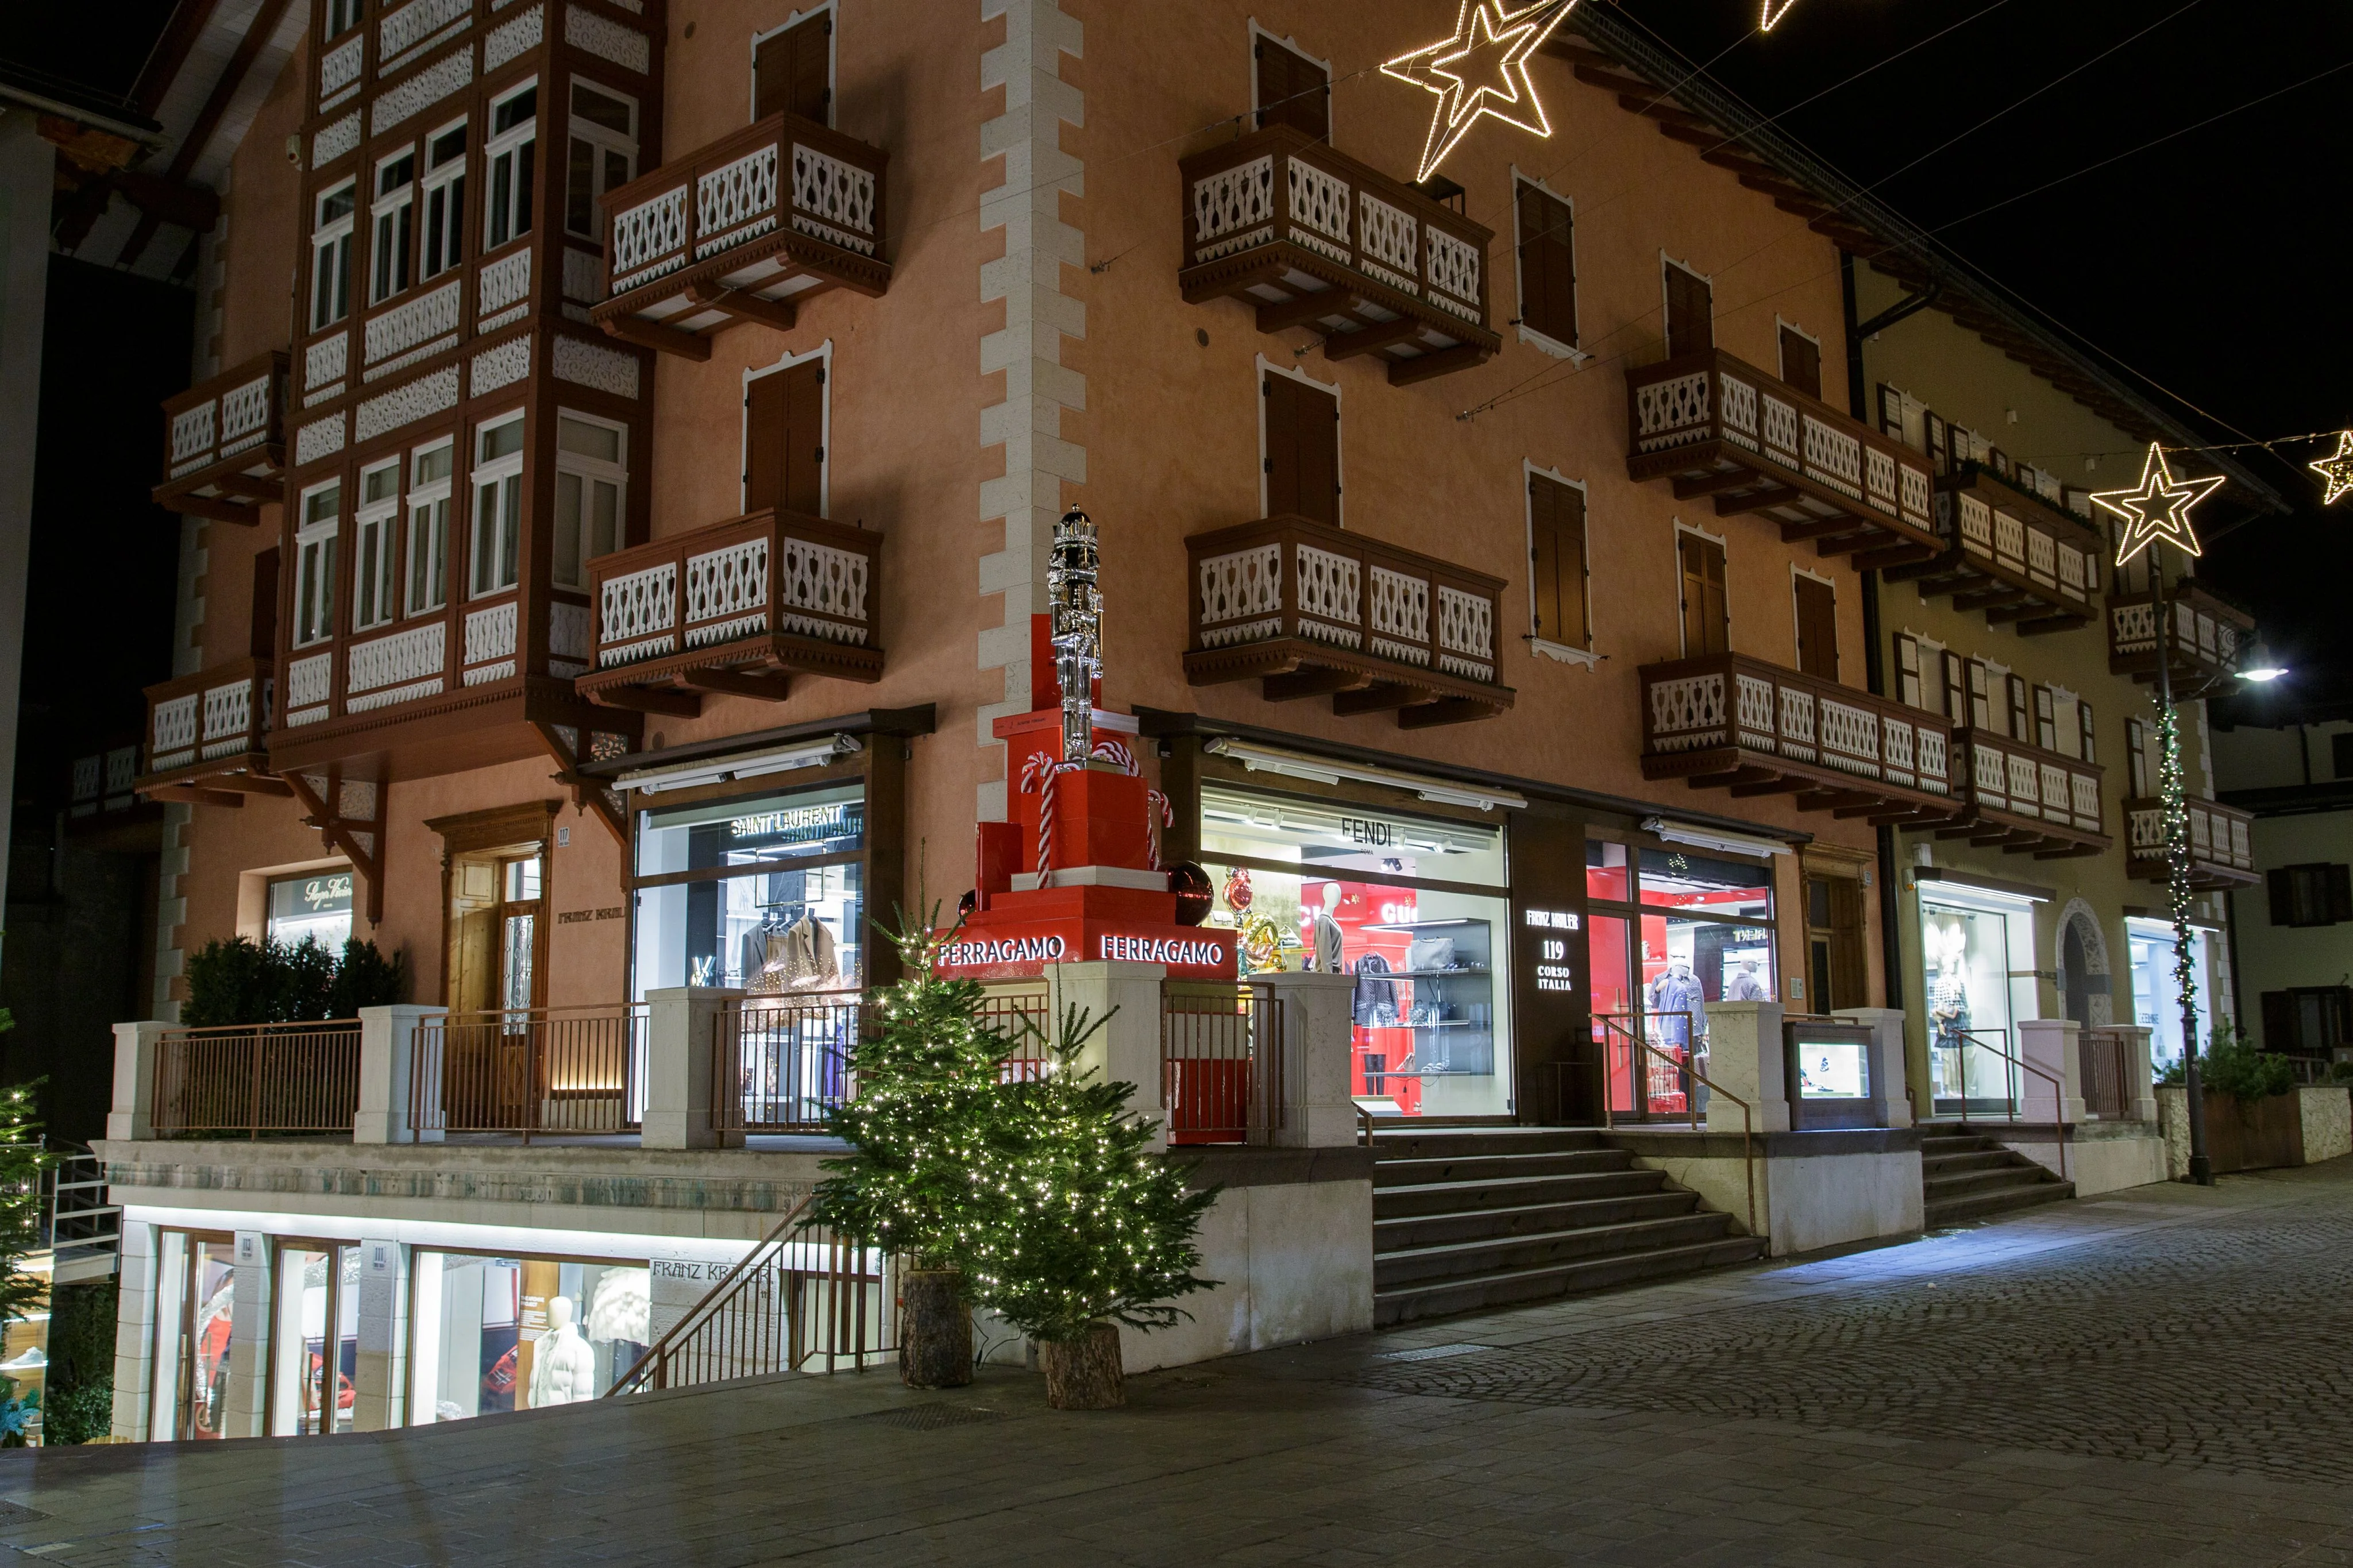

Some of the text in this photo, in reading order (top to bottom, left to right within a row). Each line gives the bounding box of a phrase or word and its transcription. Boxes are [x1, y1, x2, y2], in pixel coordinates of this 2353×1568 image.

[731, 805, 844, 836] SAINT LAURENT
[560, 828, 568, 840] 117
[1342, 817, 1391, 847] FENDI
[558, 907, 626, 924] FRANZ KRAL
[938, 935, 1066, 967] FERRAGAMO
[1101, 935, 1224, 966] FERRAGAMO
[1544, 940, 1564, 960] 119
[1537, 965, 1570, 978] CORSO
[1538, 978, 1572, 991] ITALIA
[375, 1247, 384, 1261] 111
[653, 1261, 774, 1285] FRANZ KRER
